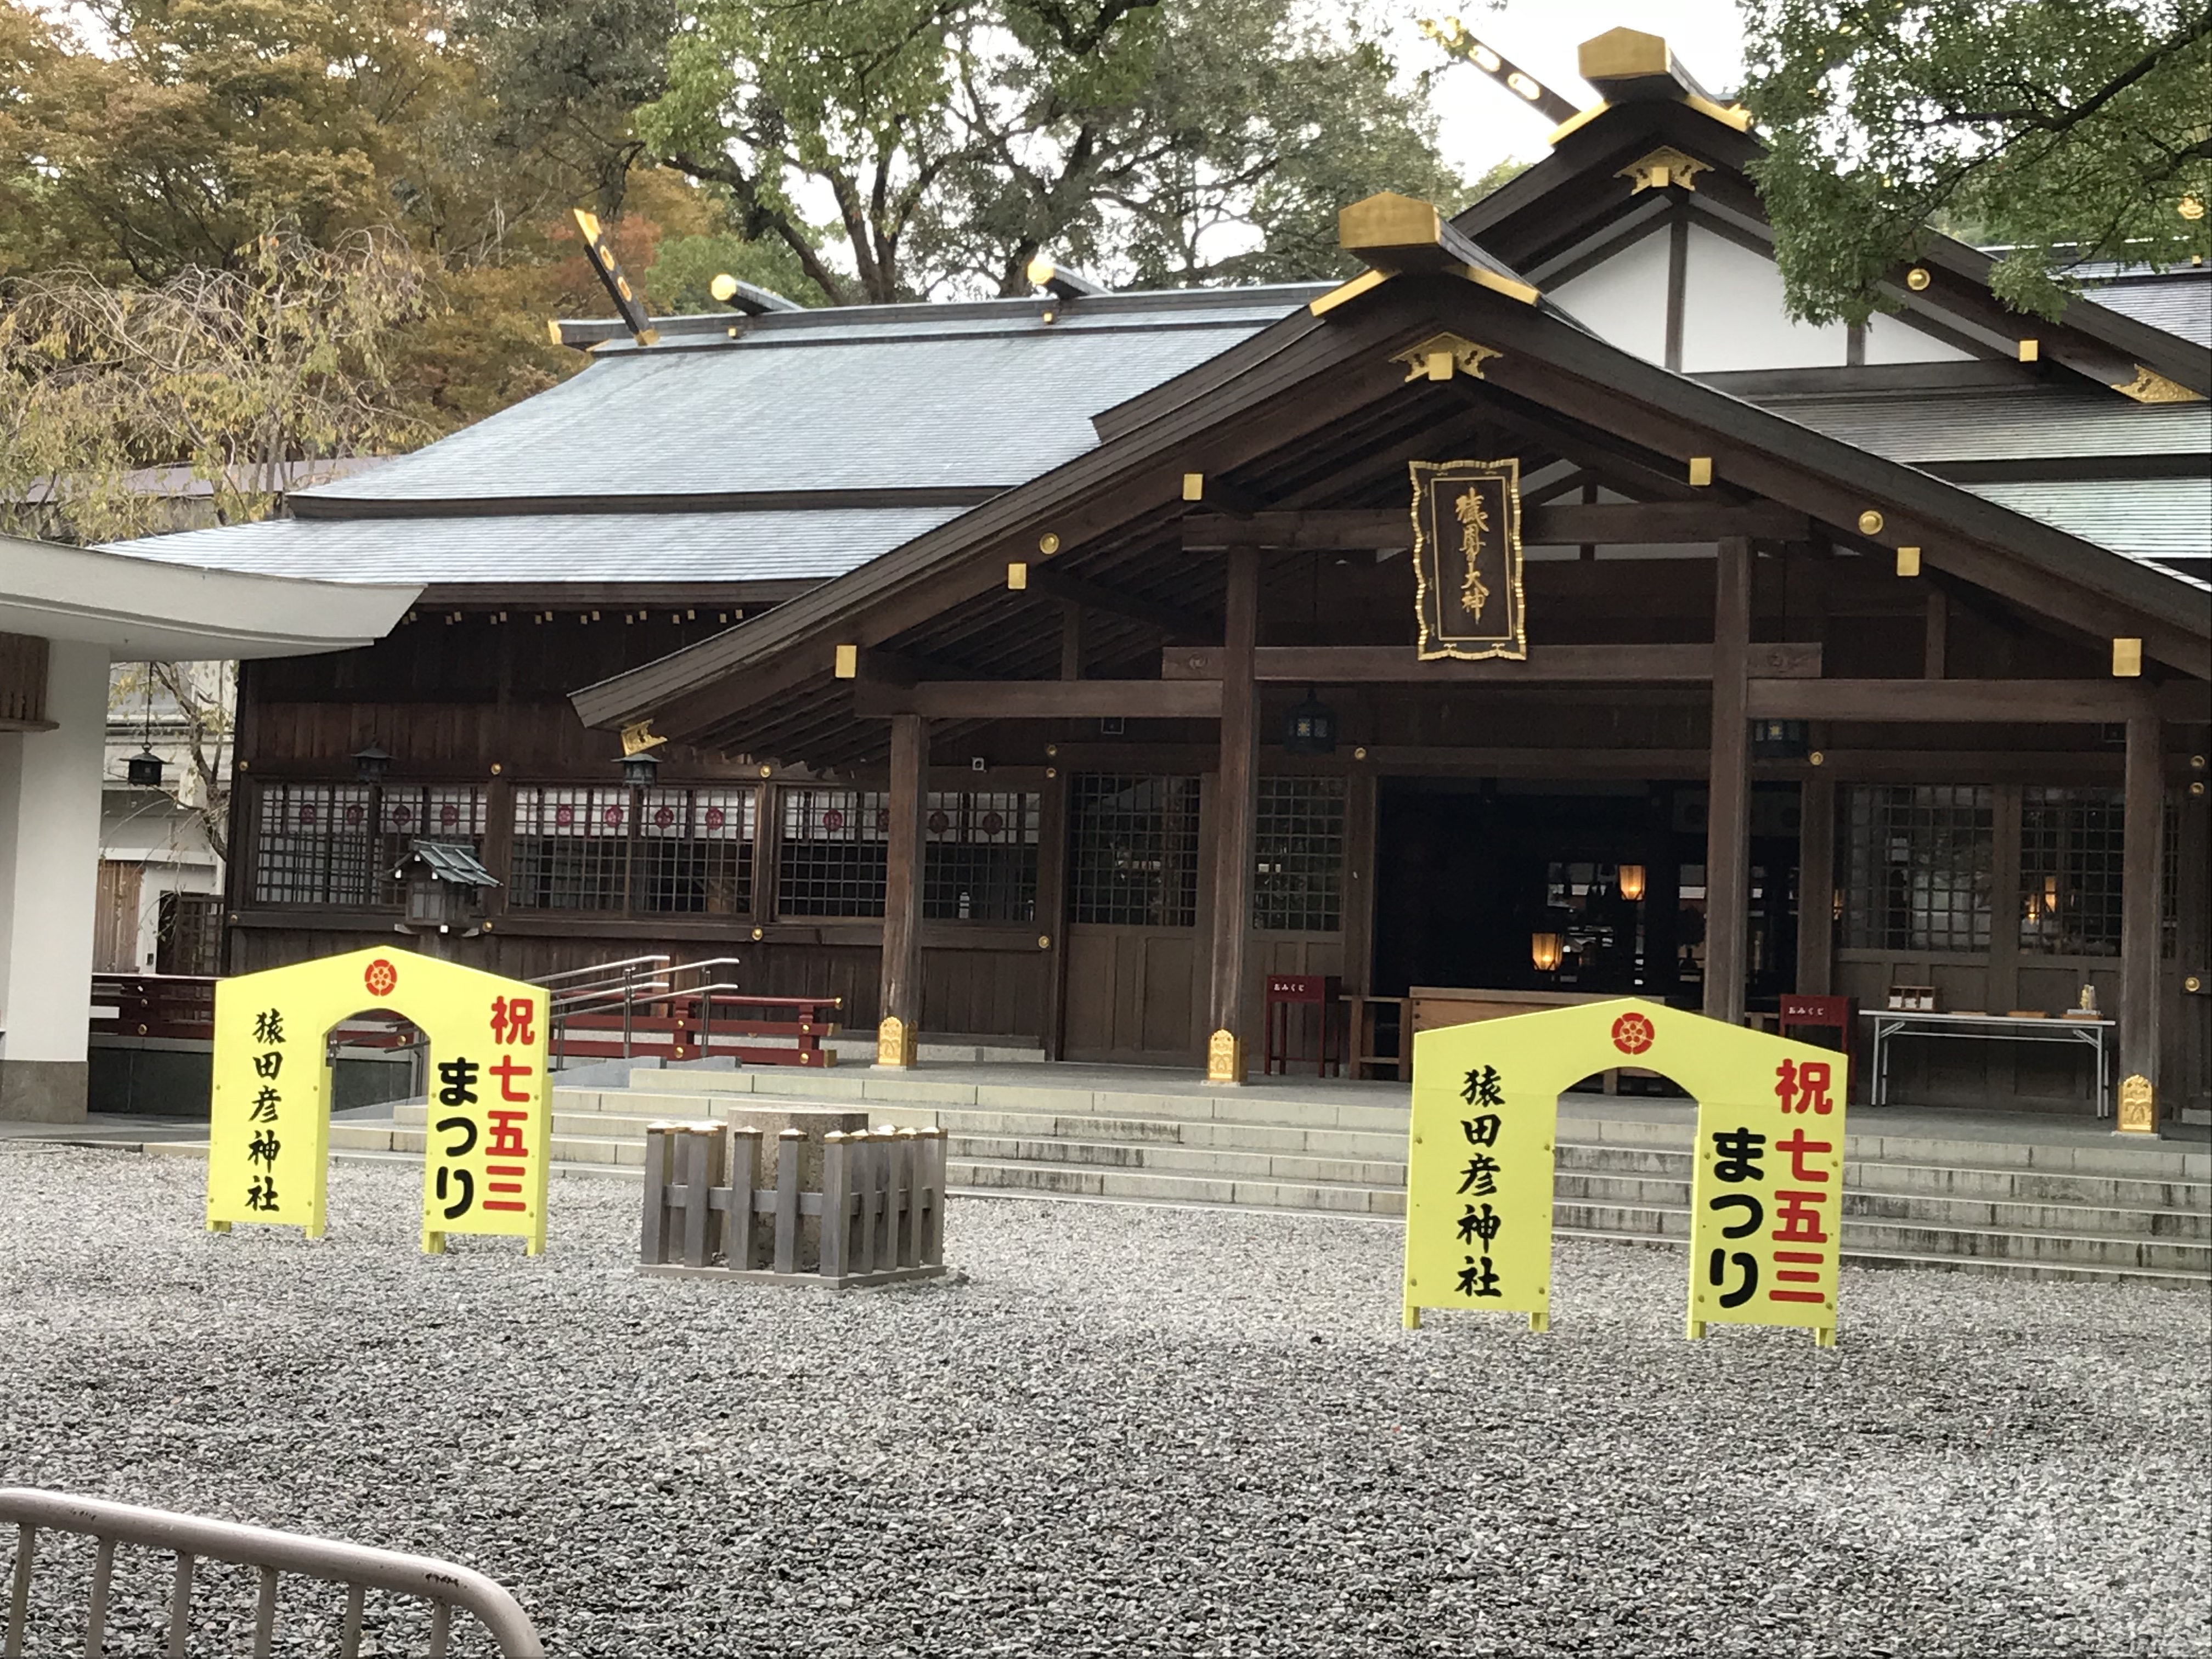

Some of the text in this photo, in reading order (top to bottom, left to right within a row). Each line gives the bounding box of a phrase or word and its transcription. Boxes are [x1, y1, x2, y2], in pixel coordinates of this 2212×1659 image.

[245, 1008, 286, 1212] 猿田彦神社
[436, 1057, 479, 1220] まつり
[483, 996, 535, 1212] 祝七五三
[1454, 1065, 1506, 1298] 猿田彦神社
[1769, 1058, 1833, 1304] 祝七五三
[1709, 1127, 1767, 1309] まつり
